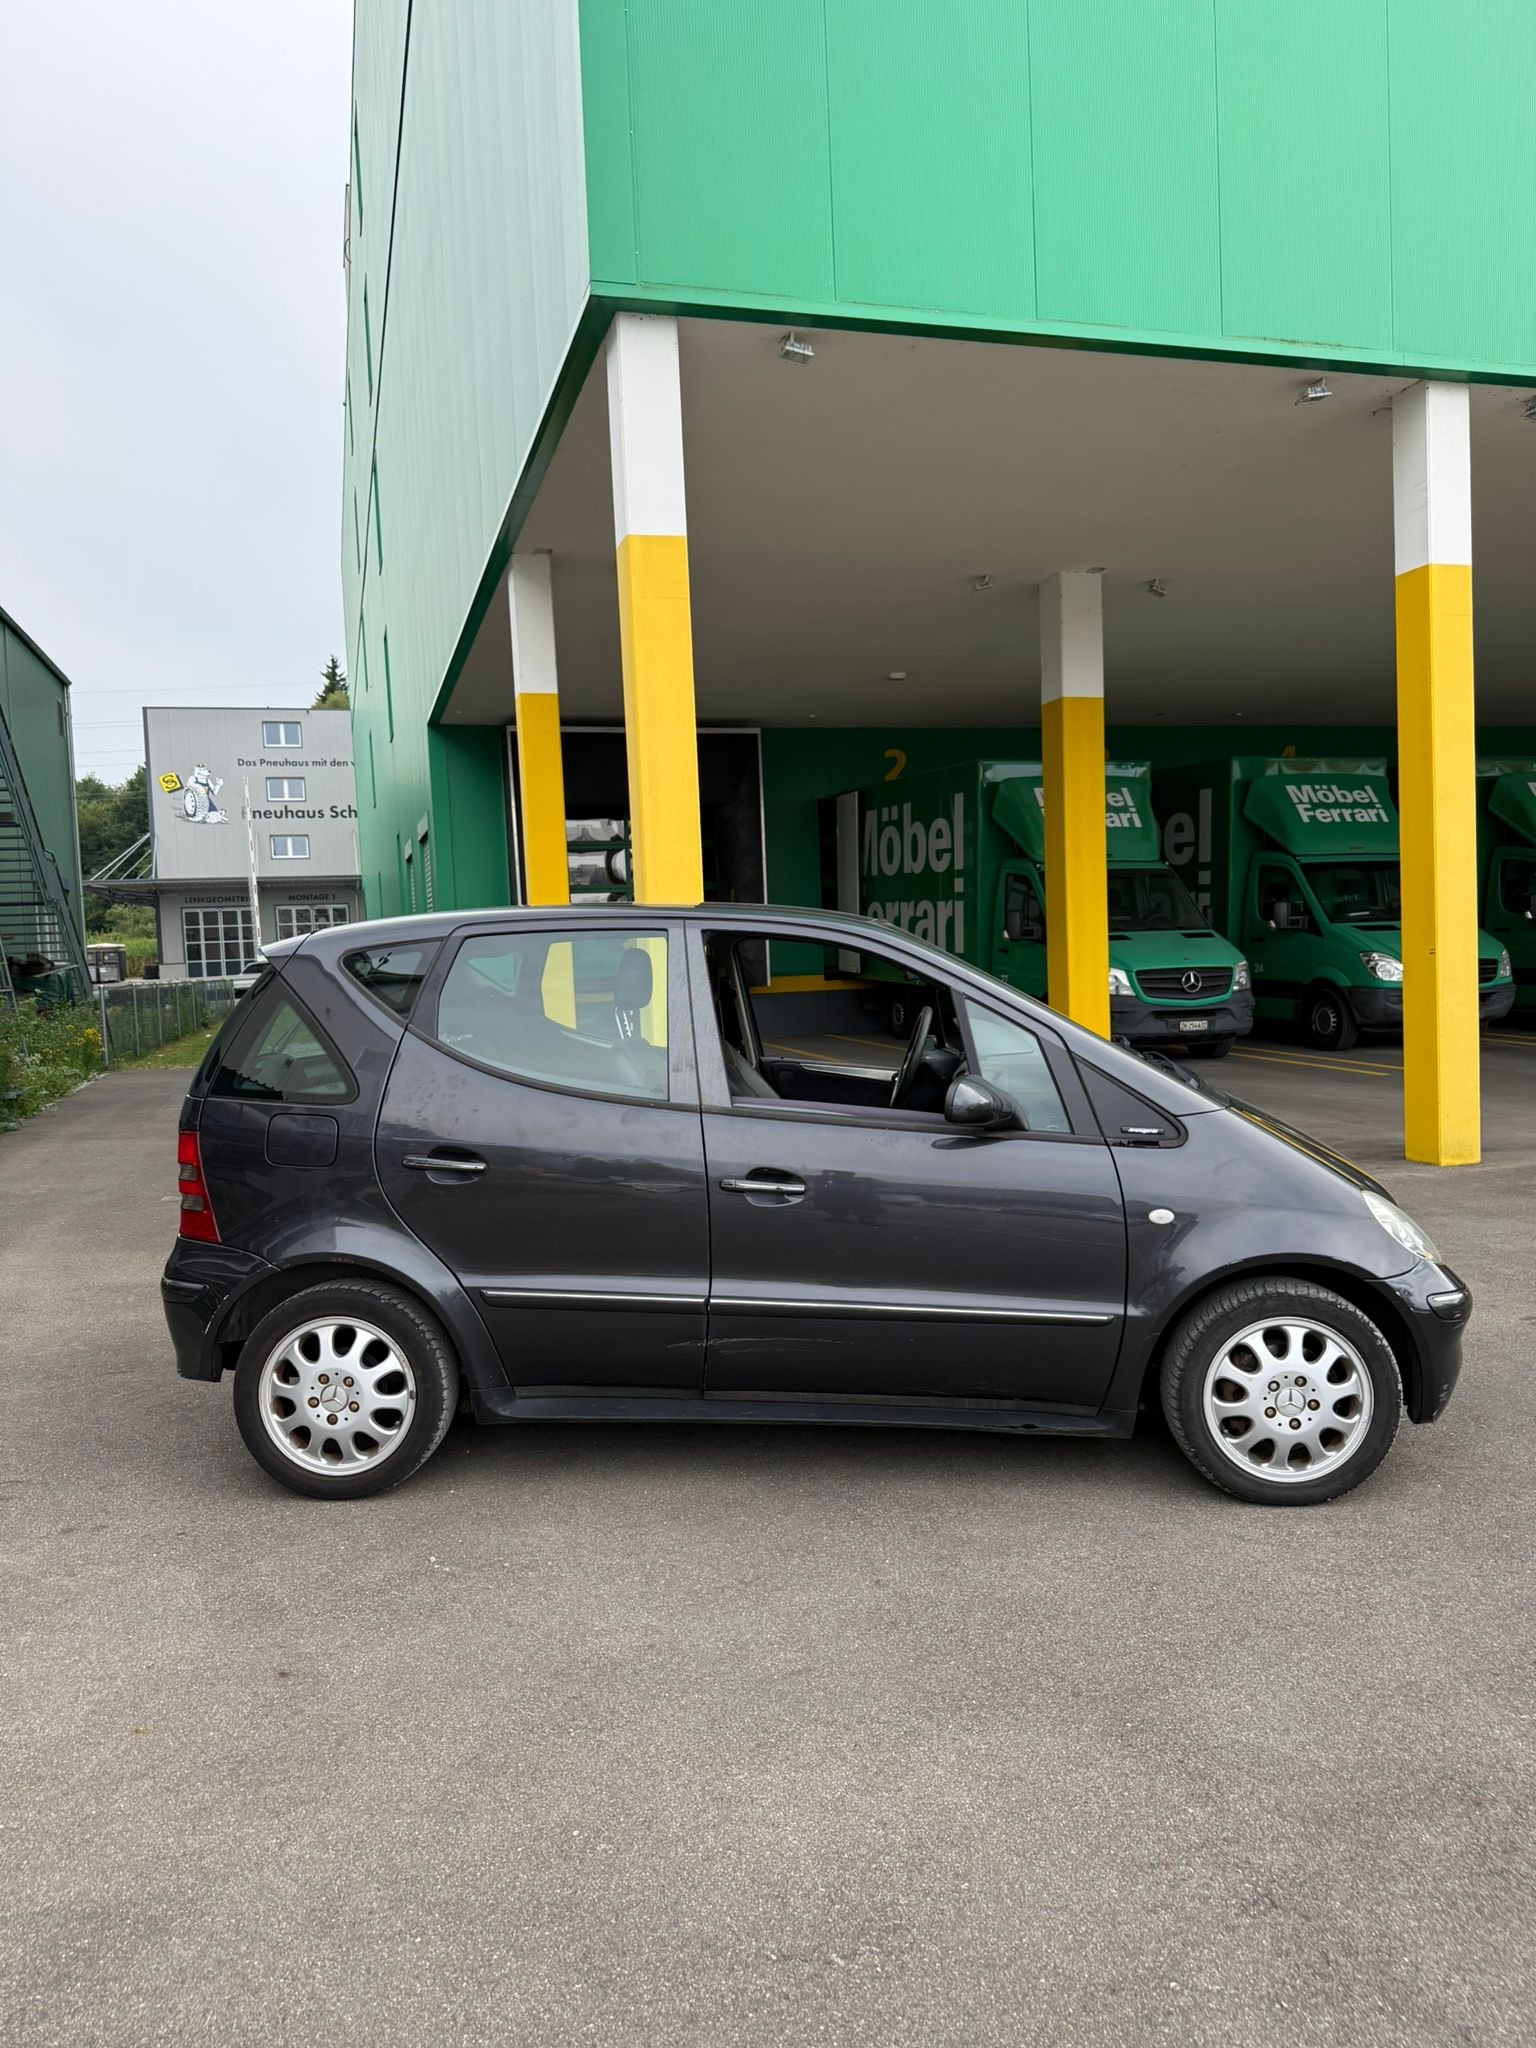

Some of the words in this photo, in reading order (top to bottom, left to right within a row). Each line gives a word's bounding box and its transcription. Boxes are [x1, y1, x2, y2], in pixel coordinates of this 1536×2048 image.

[237, 758, 257, 767] Das
[260, 758, 309, 767] Pneuhaus
[312, 758, 327, 767] mit
[330, 758, 348, 767] den
[883, 749, 907, 782] 2
[1285, 784, 1379, 803] Möbel
[1295, 803, 1390, 823] Ferrari
[288, 893, 330, 901] MONTAGE
